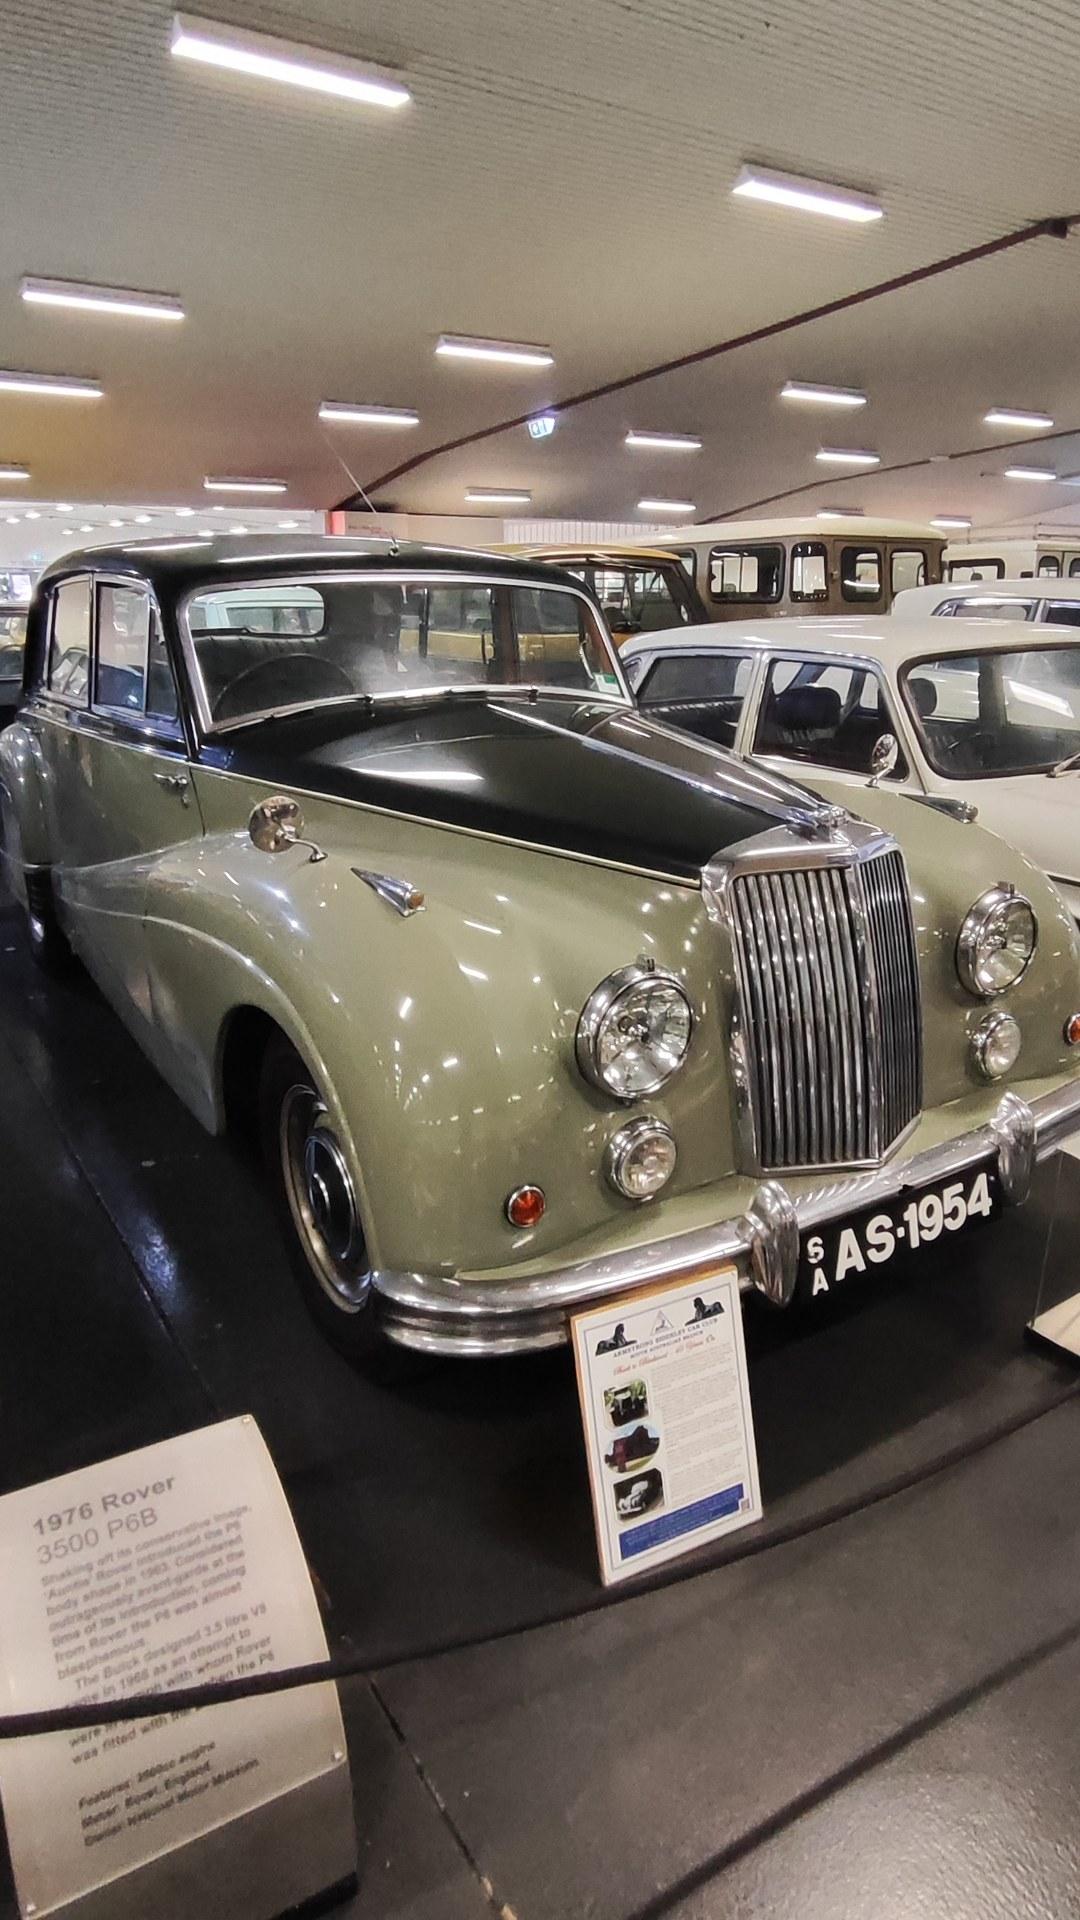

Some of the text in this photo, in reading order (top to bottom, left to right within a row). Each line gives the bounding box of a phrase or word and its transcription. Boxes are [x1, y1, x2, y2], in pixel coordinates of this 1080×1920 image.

[33, 1476, 175, 1535] 1976 Rover
[37, 1507, 158, 1564] 3500 P6B
[96, 1562, 132, 1581] Rover
[136, 1534, 201, 1566] introduced
[203, 1528, 223, 1540] the
[135, 1519, 210, 1552] conservative
[46, 1598, 78, 1617] body
[83, 1581, 121, 1602] shape
[175, 1534, 243, 1567] Considered
[49, 1593, 133, 1631] outrageously
[226, 1549, 245, 1562] the
[52, 1629, 79, 1647] time
[84, 1621, 96, 1635] of
[202, 1565, 246, 1588] coming
[55, 1645, 85, 1664] from
[89, 1628, 127, 1648] Rover
[131, 1618, 150, 1633] the
[175, 1600, 198, 1615] was
[202, 1581, 241, 1605] almost
[76, 1674, 99, 1690] The
[104, 1656, 140, 1679] Buick
[143, 1629, 201, 1663] designed
[103, 1684, 116, 1698] in
[153, 1662, 167, 1677] as
[171, 1655, 186, 1669] an
[190, 1632, 236, 1662] attempt
[239, 1628, 251, 1641] to
[166, 1670, 193, 1688] with
[236, 1635, 271, 1659] Rover
[237, 1660, 256, 1676] the
[70, 1727, 100, 1747] were
[72, 1747, 98, 1765] was
[103, 1726, 137, 1750] fitted
[141, 1714, 168, 1735] with
